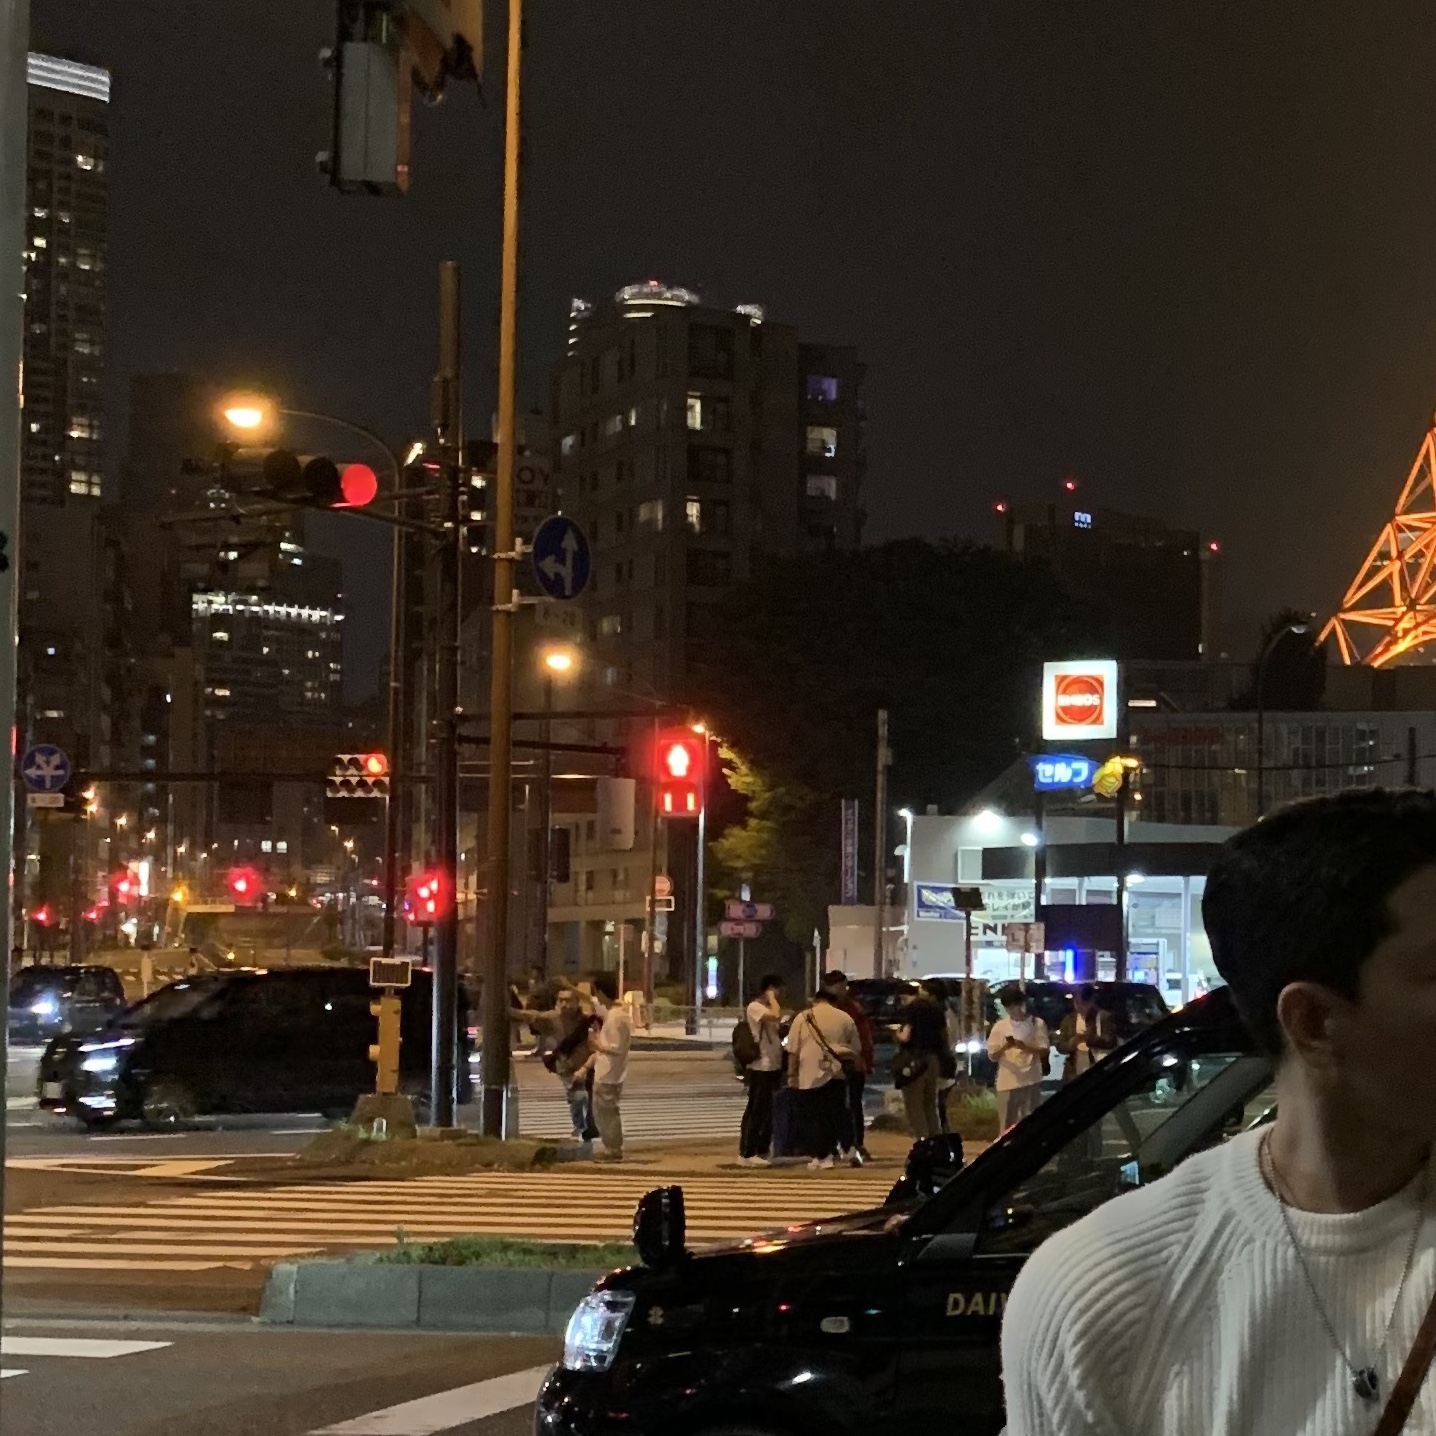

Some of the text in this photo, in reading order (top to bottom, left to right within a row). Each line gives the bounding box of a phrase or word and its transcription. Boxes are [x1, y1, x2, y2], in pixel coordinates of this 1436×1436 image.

[1057, 693, 1101, 707] ENEOS
[1035, 762, 1090, 784] セルフ
